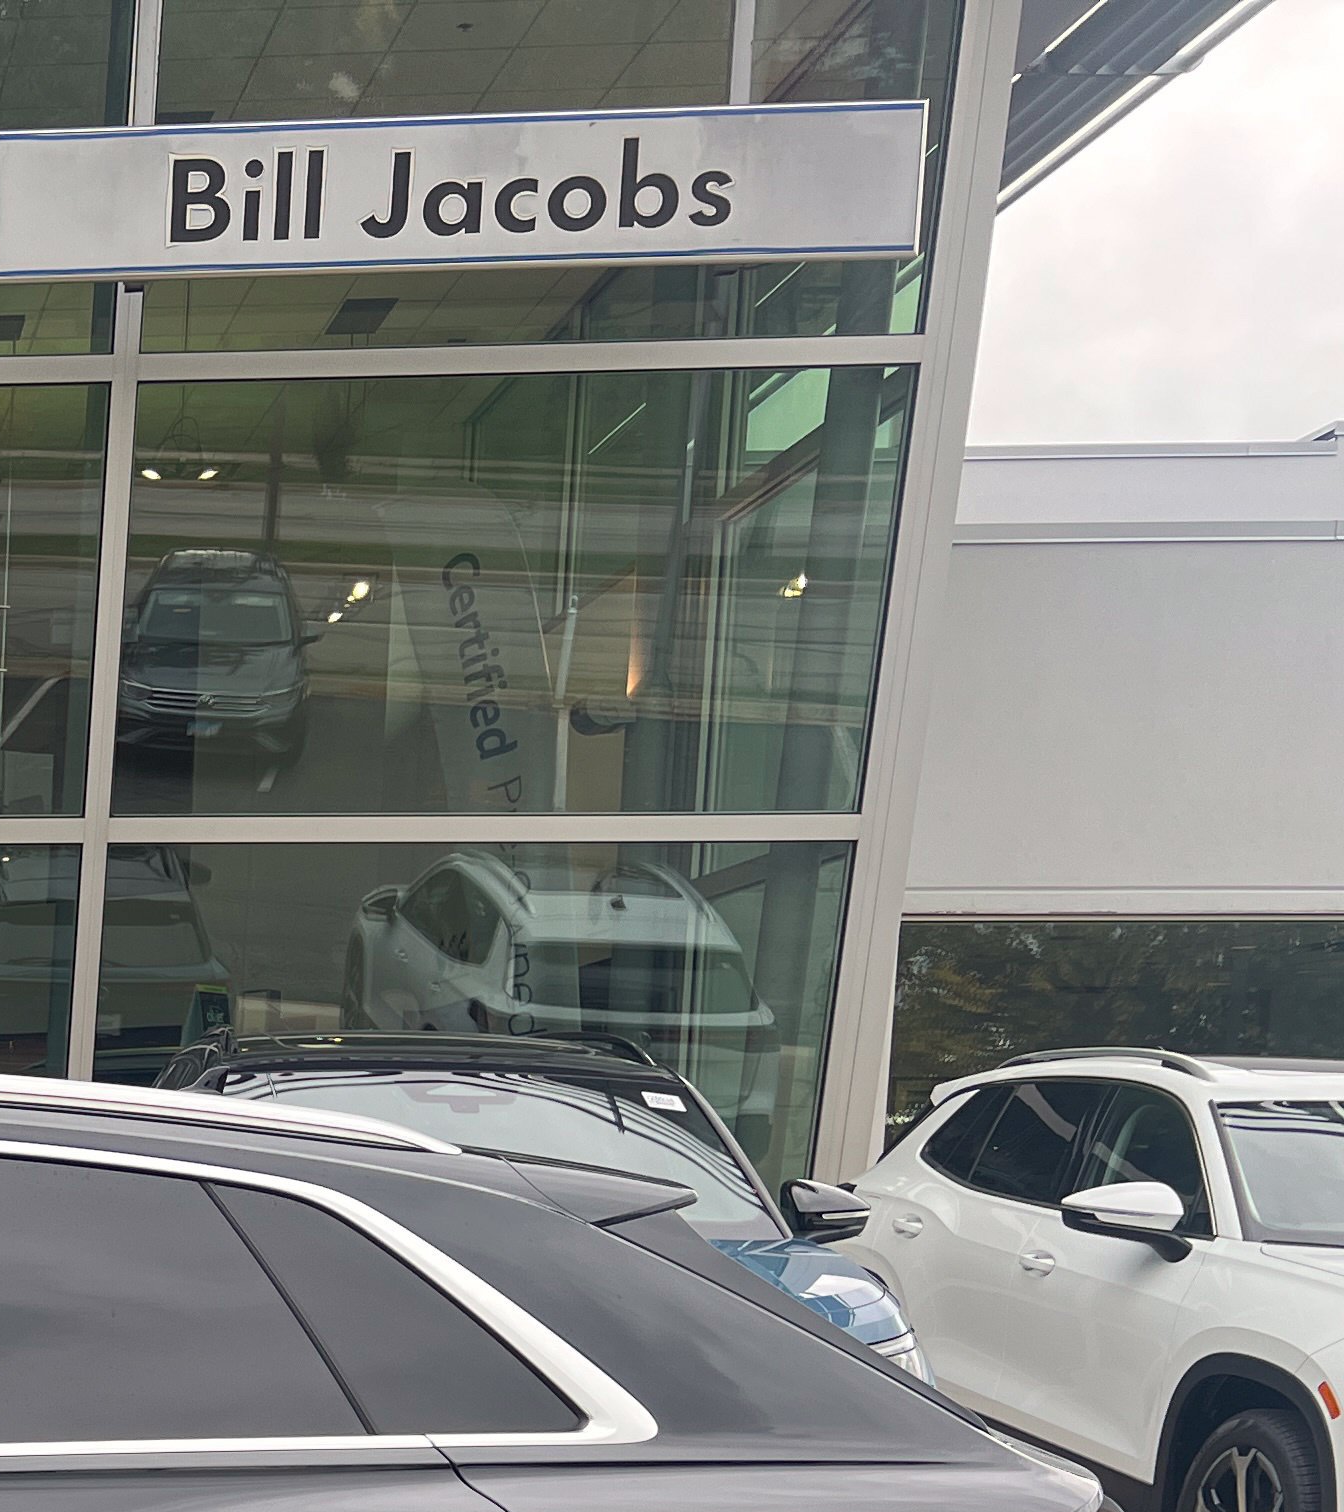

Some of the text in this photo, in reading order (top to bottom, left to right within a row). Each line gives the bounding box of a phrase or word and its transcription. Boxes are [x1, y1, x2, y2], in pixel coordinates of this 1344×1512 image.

[169, 136, 736, 244] Bill Jacobs
[442, 552, 518, 761] Certified
